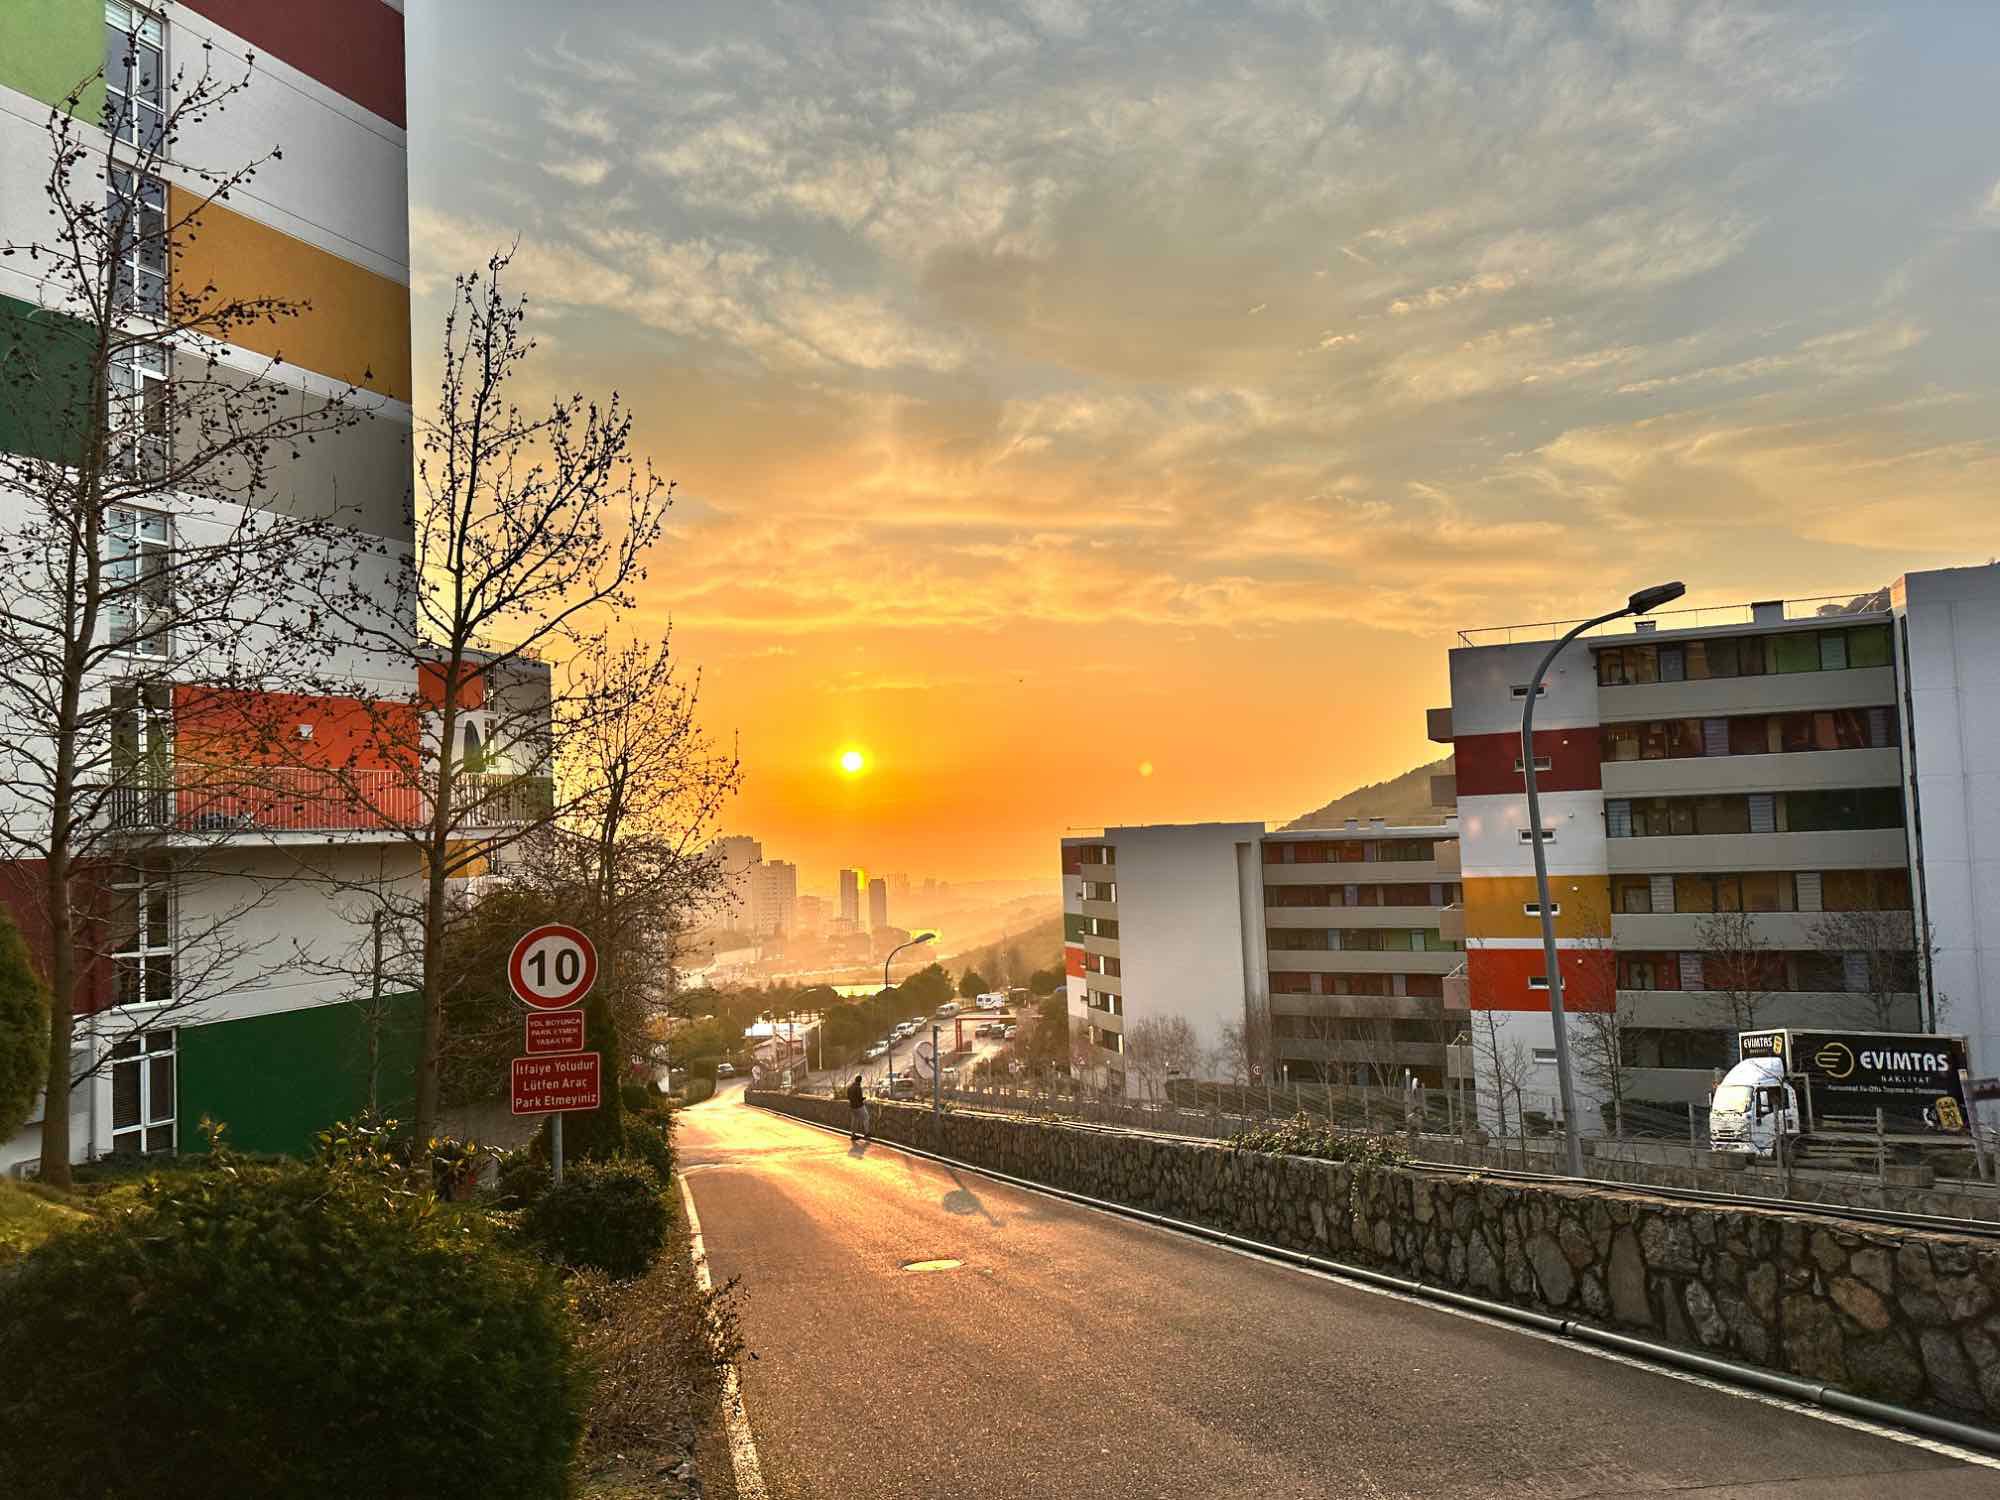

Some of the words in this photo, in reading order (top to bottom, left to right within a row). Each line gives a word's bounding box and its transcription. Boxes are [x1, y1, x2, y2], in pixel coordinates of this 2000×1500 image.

[528, 949, 580, 987] 10
[555, 1059, 594, 1072] Yoludur
[523, 1079, 559, 1092] Lütfen
[515, 1096, 541, 1109] Park
[544, 1092, 597, 1106] Etmeyiniz
